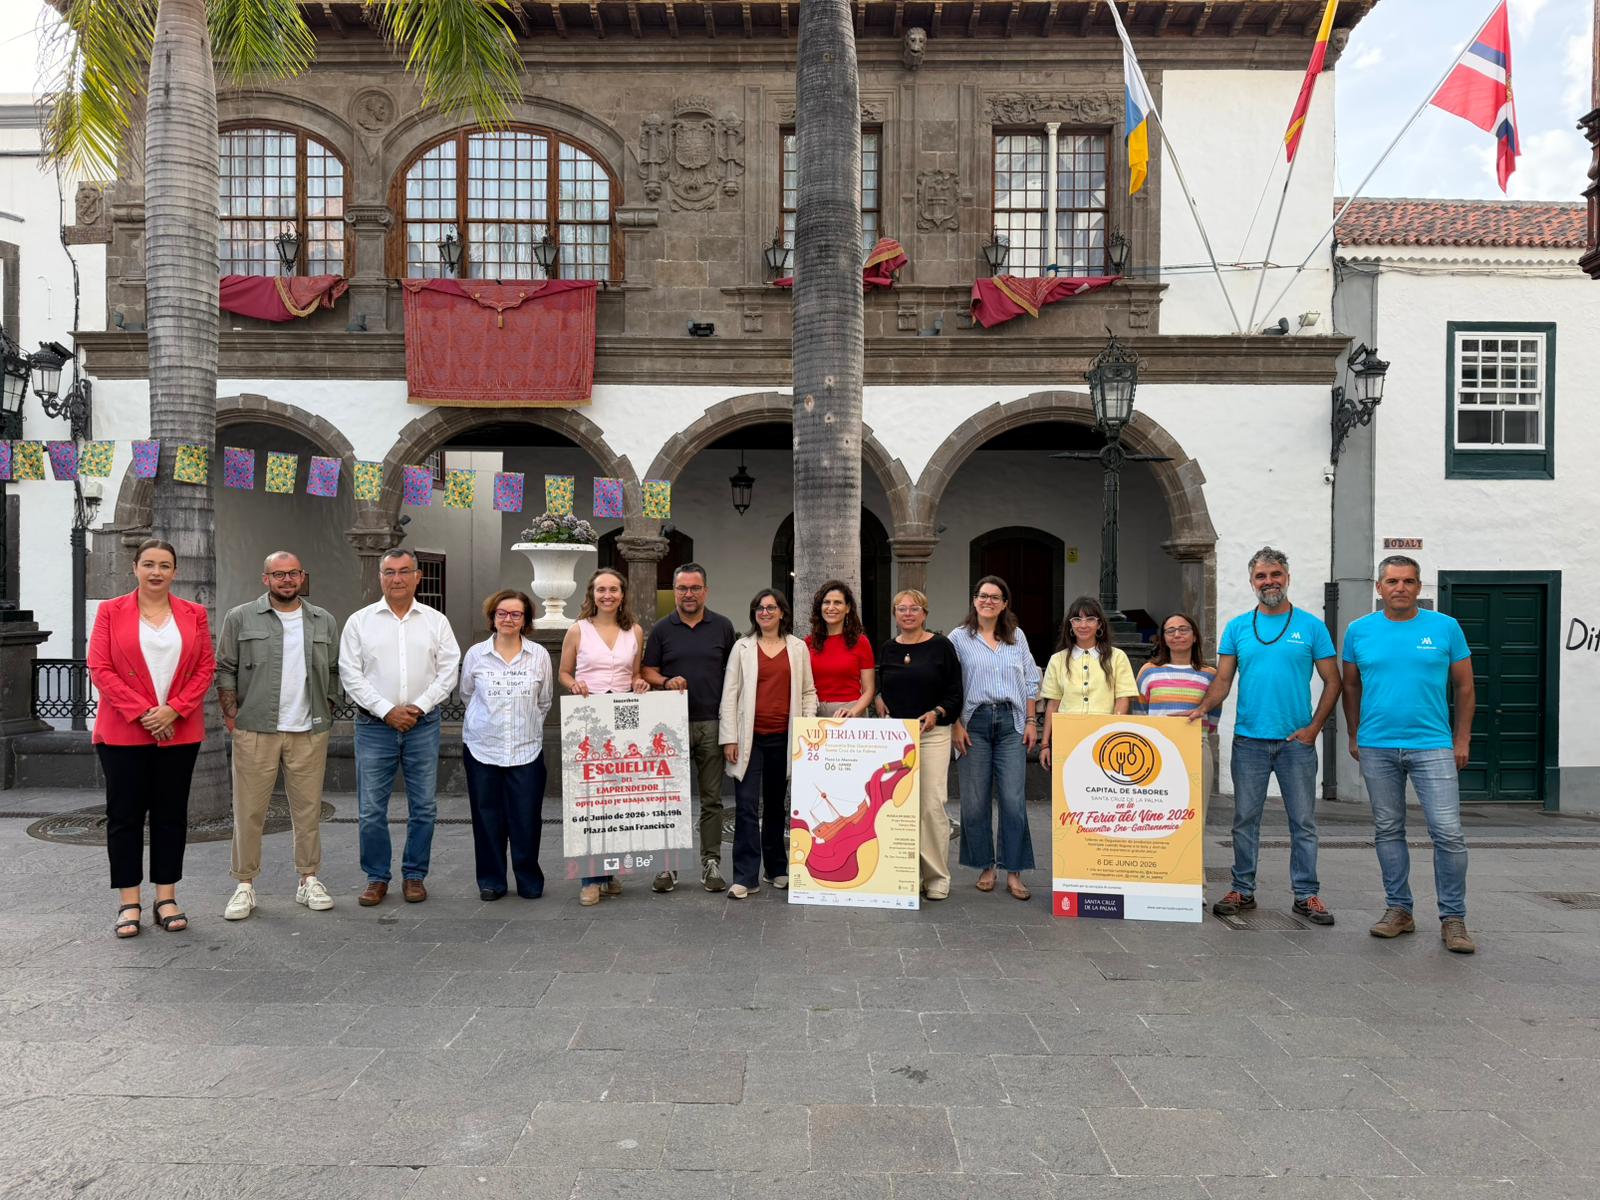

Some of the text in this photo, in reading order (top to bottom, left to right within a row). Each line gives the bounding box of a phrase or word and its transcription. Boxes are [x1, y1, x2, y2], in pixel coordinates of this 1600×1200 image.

[806, 728, 907, 741] VII FERIA DEL VINO
[807, 743, 820, 752] 20
[807, 752, 820, 761] 26
[583, 760, 671, 781] ESCUELITA
[825, 762, 836, 771] 06
[596, 784, 659, 794] EMPRENDEDOR
[1085, 786, 1117, 794] CAPITAL
[1132, 788, 1169, 796] SABORES
[1126, 801, 1135, 809] la
[590, 813, 613, 821] Junio
[614, 812, 624, 820] de
[625, 811, 646, 819] 2026
[1059, 808, 1196, 826] VII Feria del Vino 2026
[583, 826, 606, 835] Plaza
[635, 821, 676, 831] Francisco
[1076, 824, 1111, 834] Encuentro
[1096, 858, 1102, 866] 6
[1115, 859, 1138, 867] JUNIO
[1139, 860, 1157, 868] 2026
